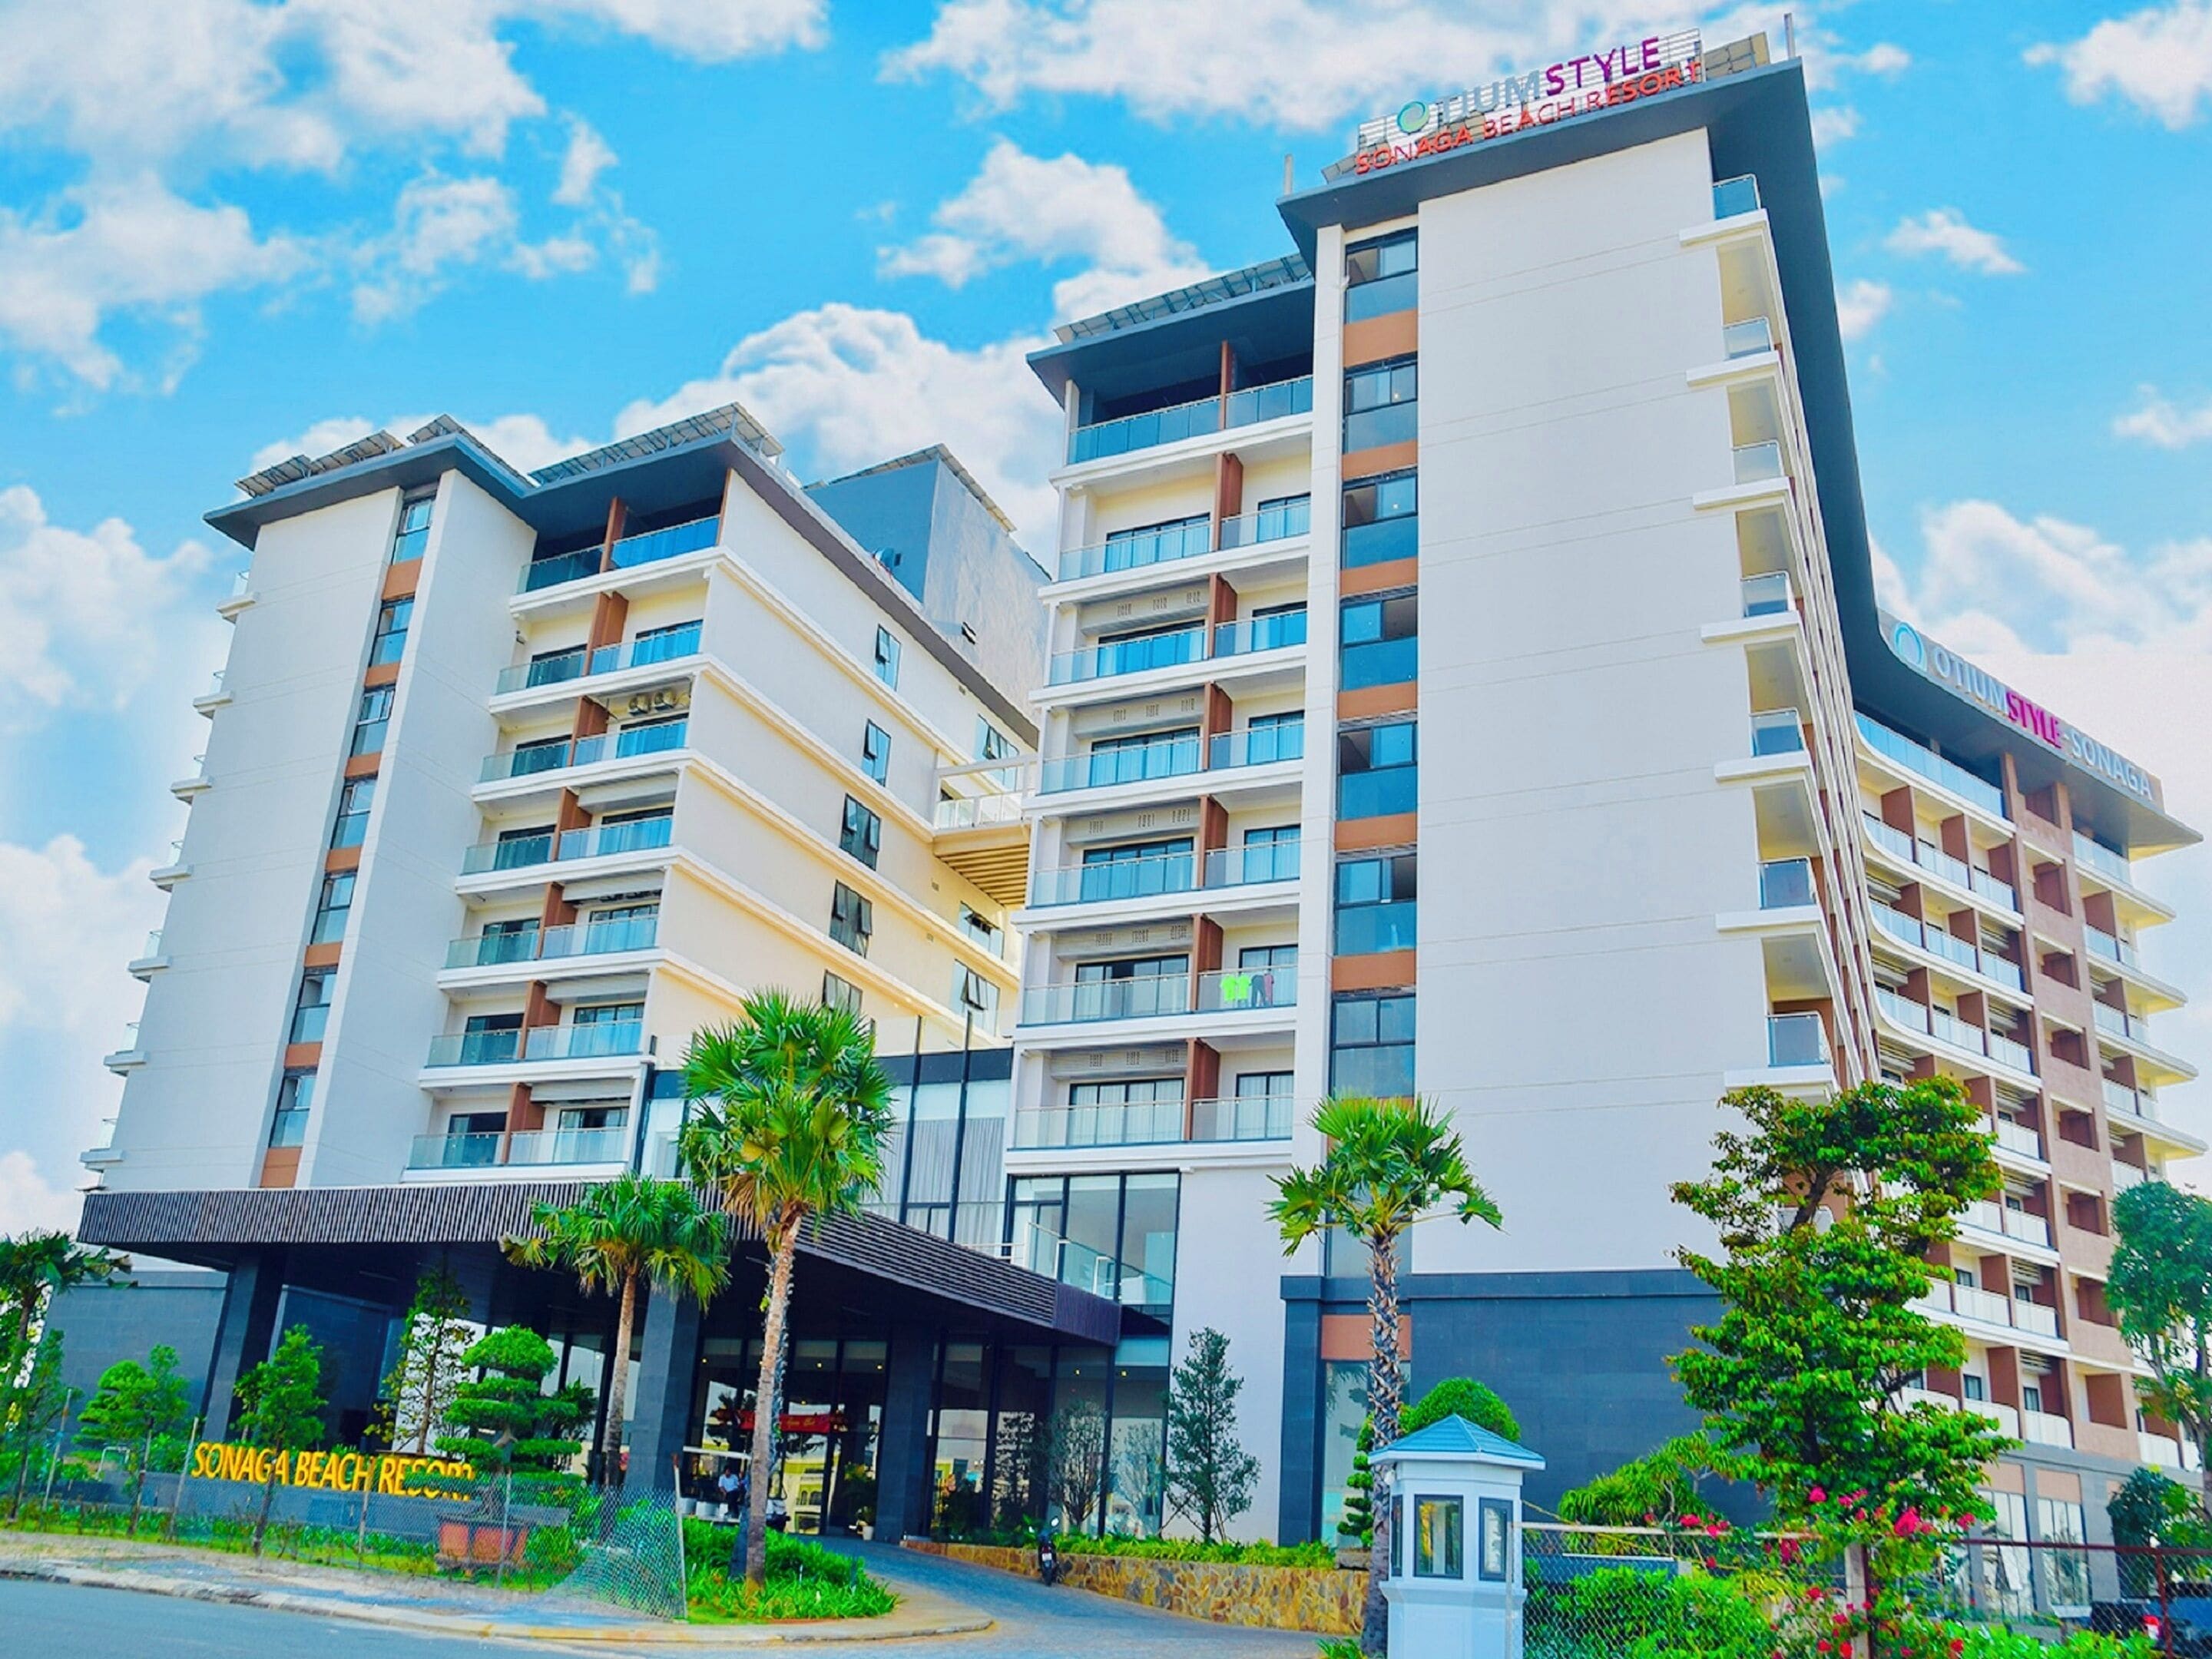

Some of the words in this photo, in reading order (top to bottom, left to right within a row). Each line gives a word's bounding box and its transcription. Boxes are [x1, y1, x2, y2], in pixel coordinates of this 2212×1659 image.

[1355, 127, 1473, 175] SONAGA
[1482, 97, 1576, 140] BEACH
[1584, 61, 1701, 113] RESORT
[2071, 728, 2153, 800] SONAGA
[192, 1441, 290, 1485] SONAGA
[294, 1451, 376, 1492] BEACH
